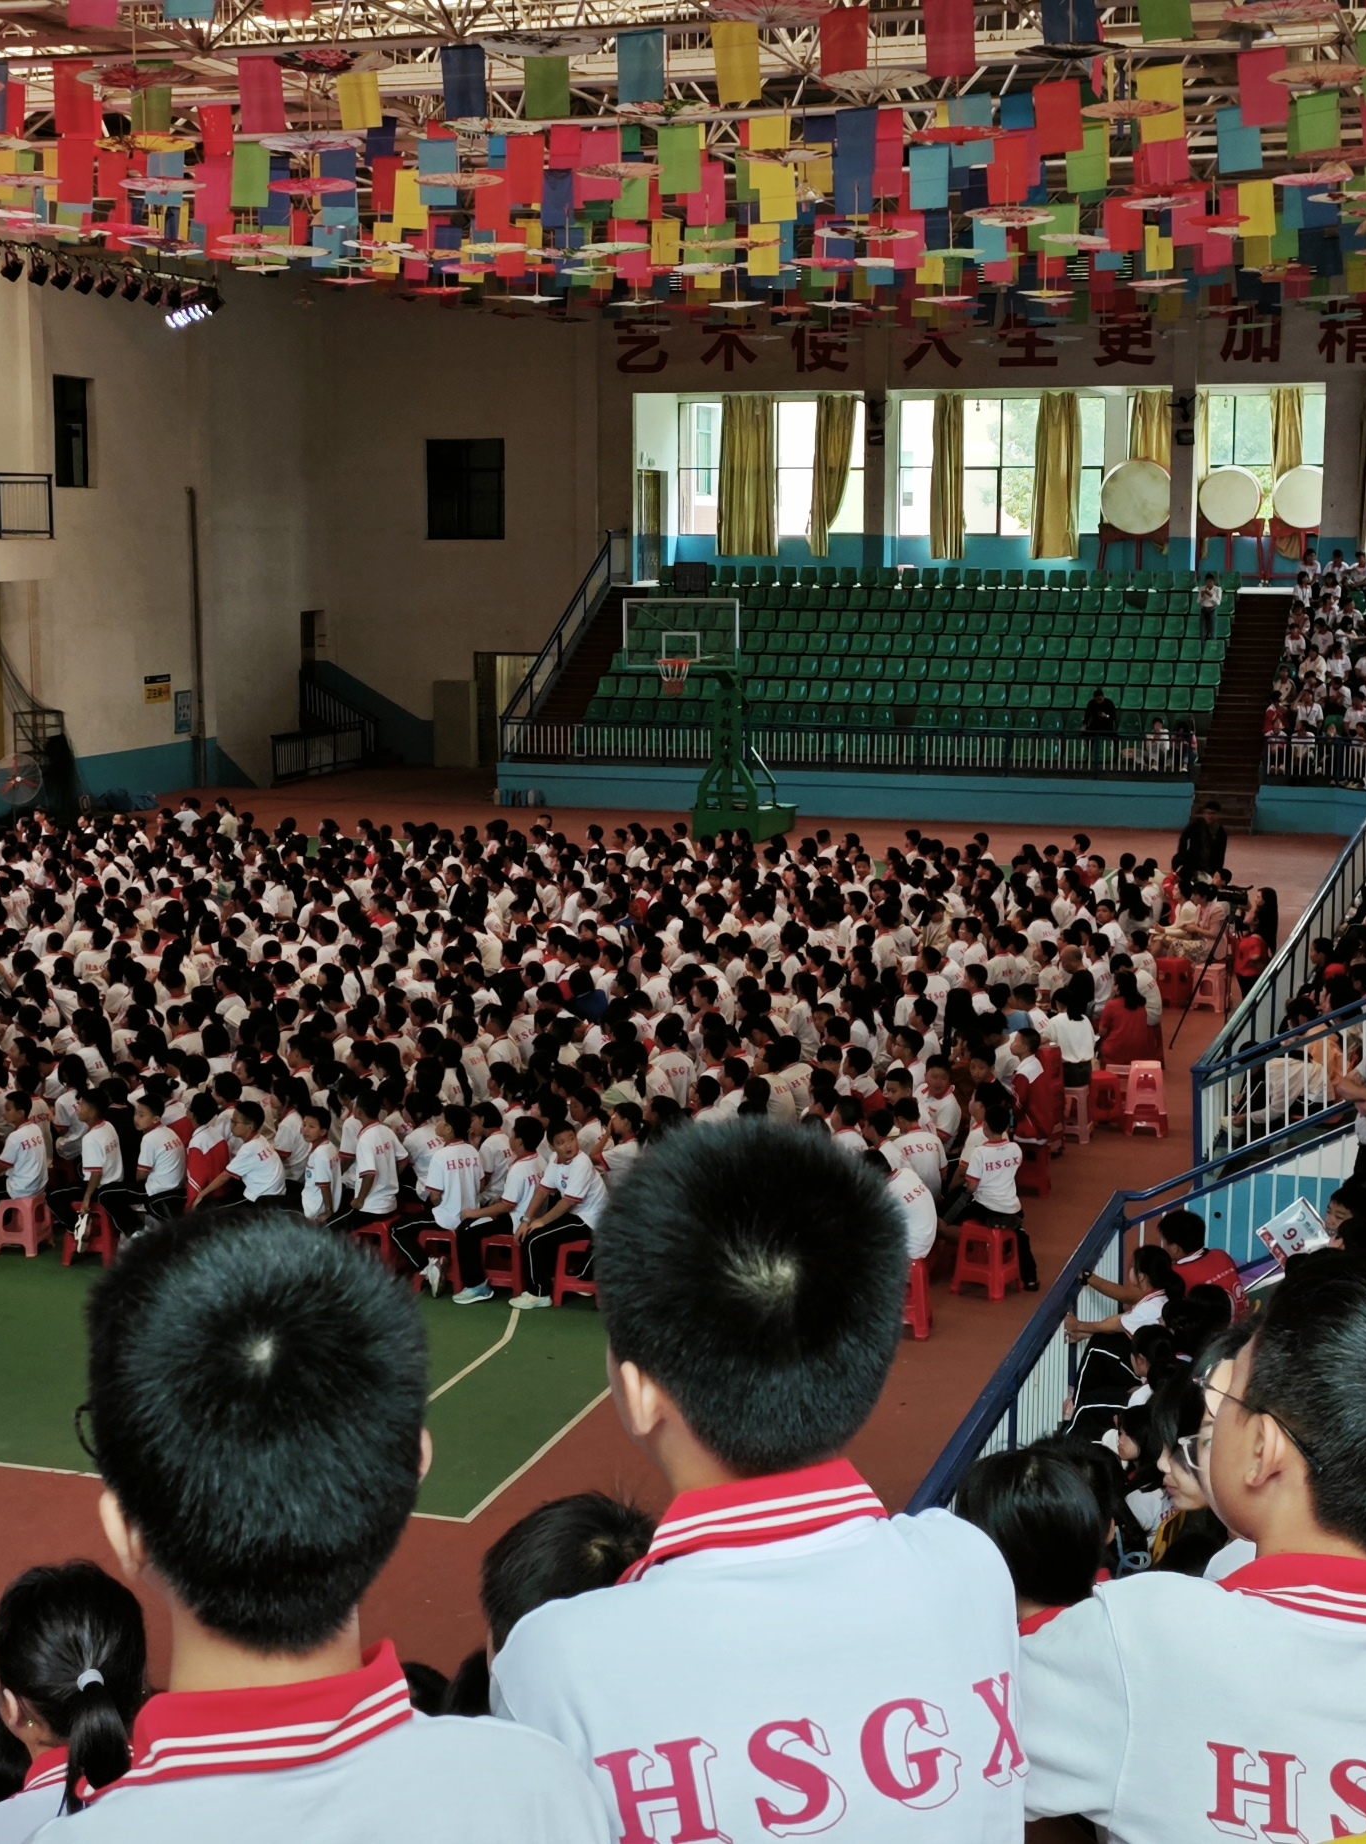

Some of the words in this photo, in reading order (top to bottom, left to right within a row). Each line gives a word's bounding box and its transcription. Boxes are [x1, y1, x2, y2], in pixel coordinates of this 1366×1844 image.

[20, 1136, 42, 1150] HSG
[446, 1158, 479, 1170] HSGX
[985, 1157, 1019, 1171] HSGX
[903, 1185, 927, 1203] HSG
[594, 1671, 1030, 1844] HSGX
